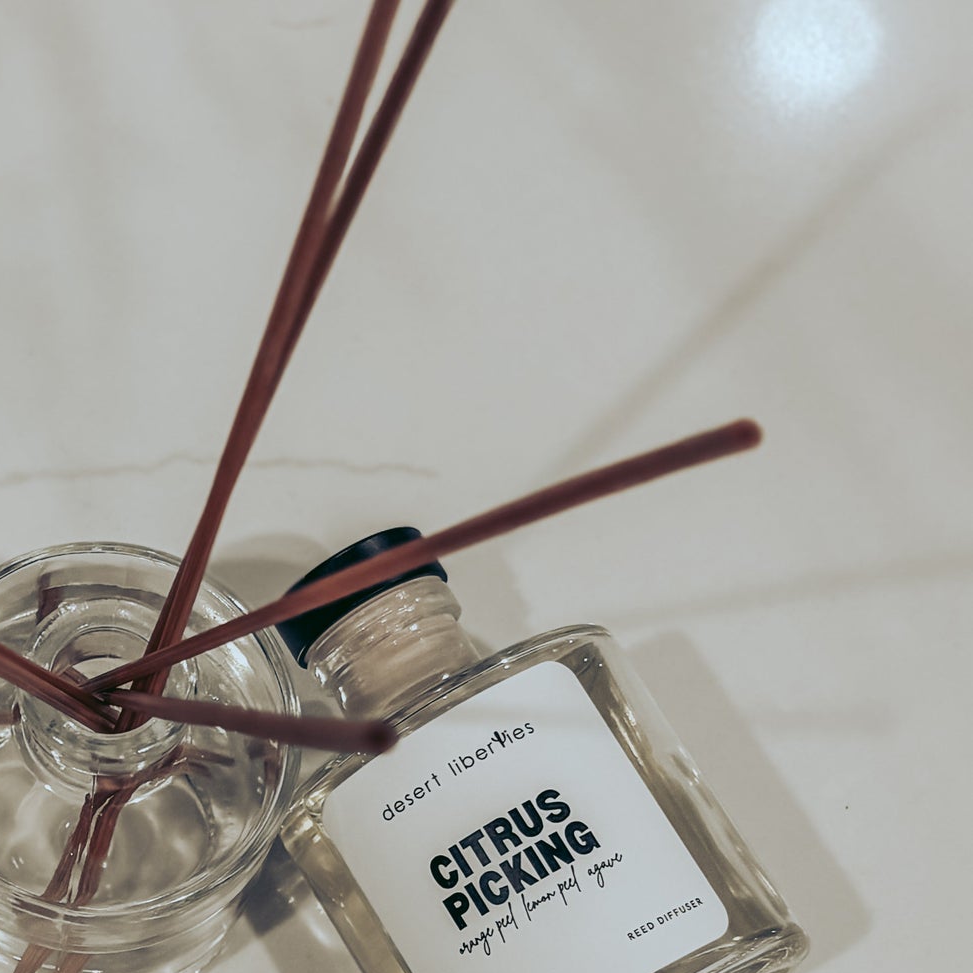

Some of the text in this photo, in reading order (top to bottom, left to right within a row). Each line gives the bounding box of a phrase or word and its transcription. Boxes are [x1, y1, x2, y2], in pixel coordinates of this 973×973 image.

[381, 720, 536, 822] desert liberties
[429, 788, 572, 890] CITRUS
[442, 820, 602, 931] PICKING
[459, 852, 623, 956] orange peel lemon peel agave
[626, 896, 704, 941] REED DIFFUSER
